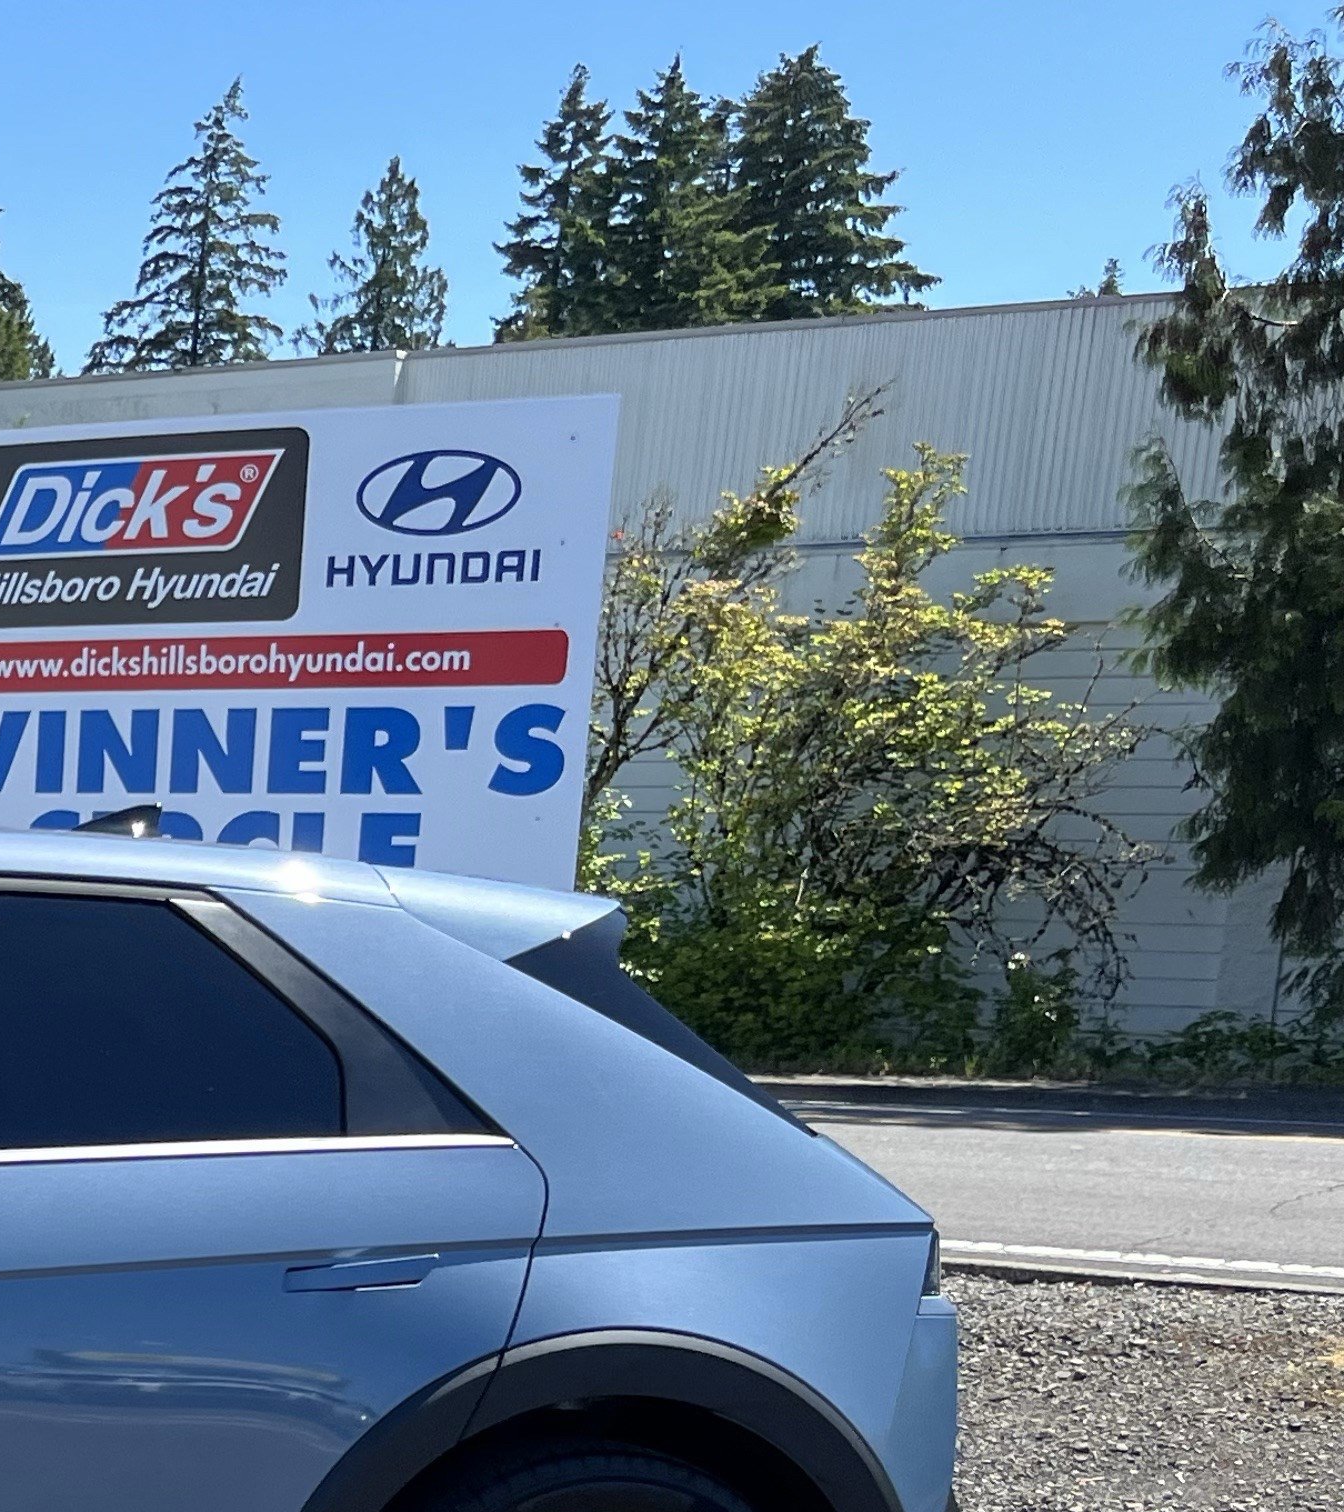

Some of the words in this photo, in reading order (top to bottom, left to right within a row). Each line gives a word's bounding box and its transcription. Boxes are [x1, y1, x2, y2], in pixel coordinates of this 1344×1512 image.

[0, 464, 242, 546] Dick's
[126, 562, 280, 609] Hyundai
[326, 549, 541, 588] HYUNDAI
